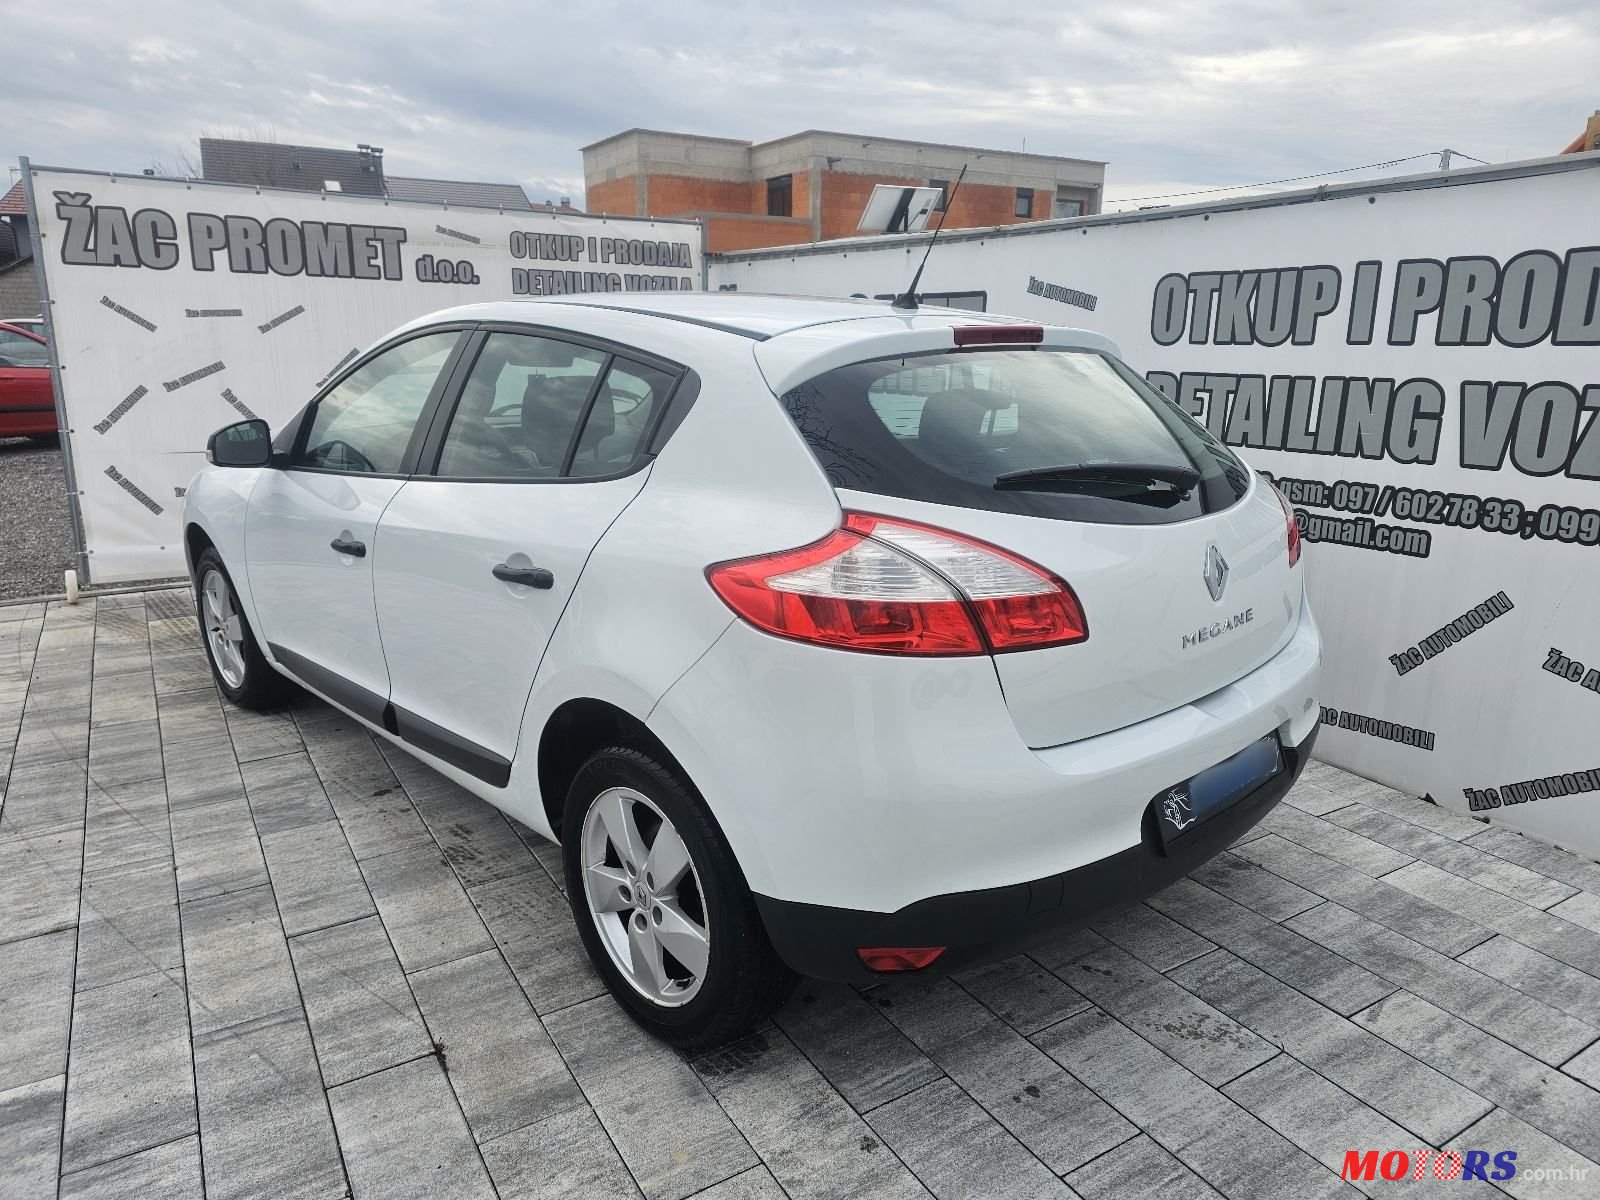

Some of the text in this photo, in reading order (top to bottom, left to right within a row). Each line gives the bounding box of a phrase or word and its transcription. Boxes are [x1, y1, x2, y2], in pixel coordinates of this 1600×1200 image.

[53, 190, 480, 285] ŽAC PROMET d.o.o.
[509, 231, 585, 262] OTKUP
[588, 236, 598, 263] I
[601, 237, 693, 268] PRODAJA
[512, 268, 622, 296] DETAILING
[1043, 283, 1098, 311] AUTOMOBILI
[1151, 264, 1342, 347] OTKUP
[1346, 260, 1383, 345] I
[1331, 479, 1379, 515] 097
[1182, 608, 1254, 649] MEGANE
[1389, 590, 1514, 676] ŽAC AUTOMOBILI
[1542, 648, 1585, 682] ŽAC
[1319, 706, 1435, 751] AC AUTOMOBILI
[1463, 788, 1501, 811] ŽAC
